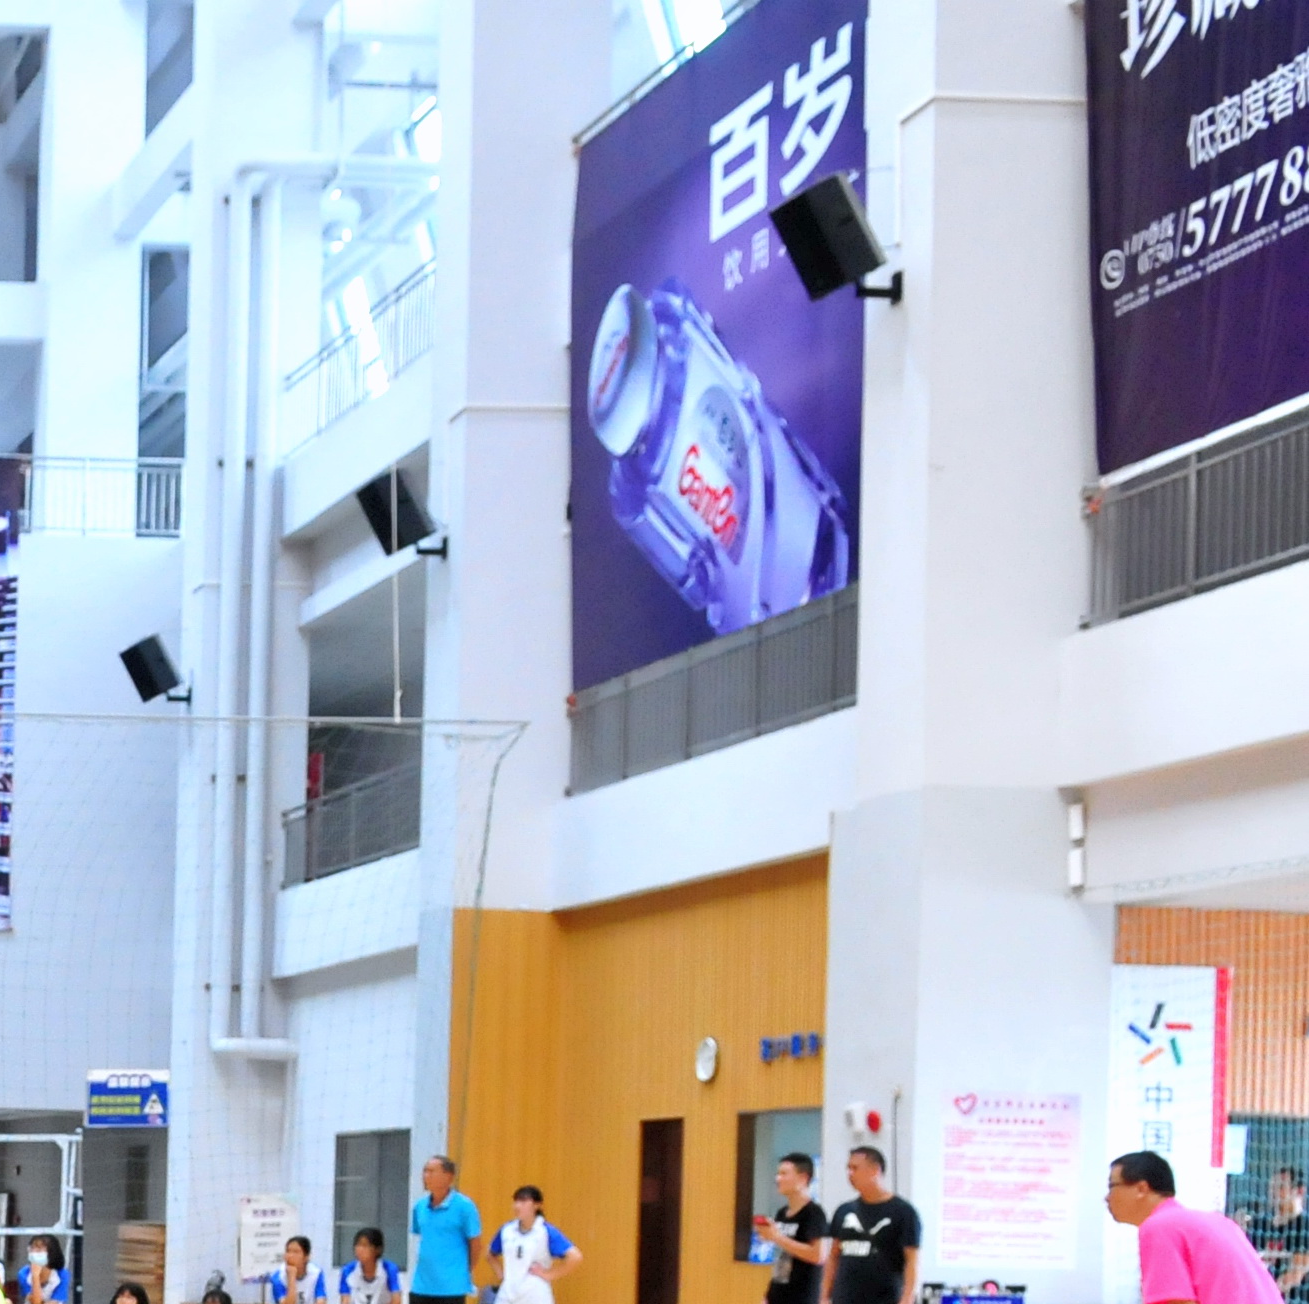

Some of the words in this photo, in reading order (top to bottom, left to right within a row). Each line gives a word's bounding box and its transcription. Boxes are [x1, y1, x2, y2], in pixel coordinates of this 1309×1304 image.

[709, 22, 853, 243] 百岁
[1183, 145, 1309, 258] 57778
[722, 227, 787, 292] 饮用
